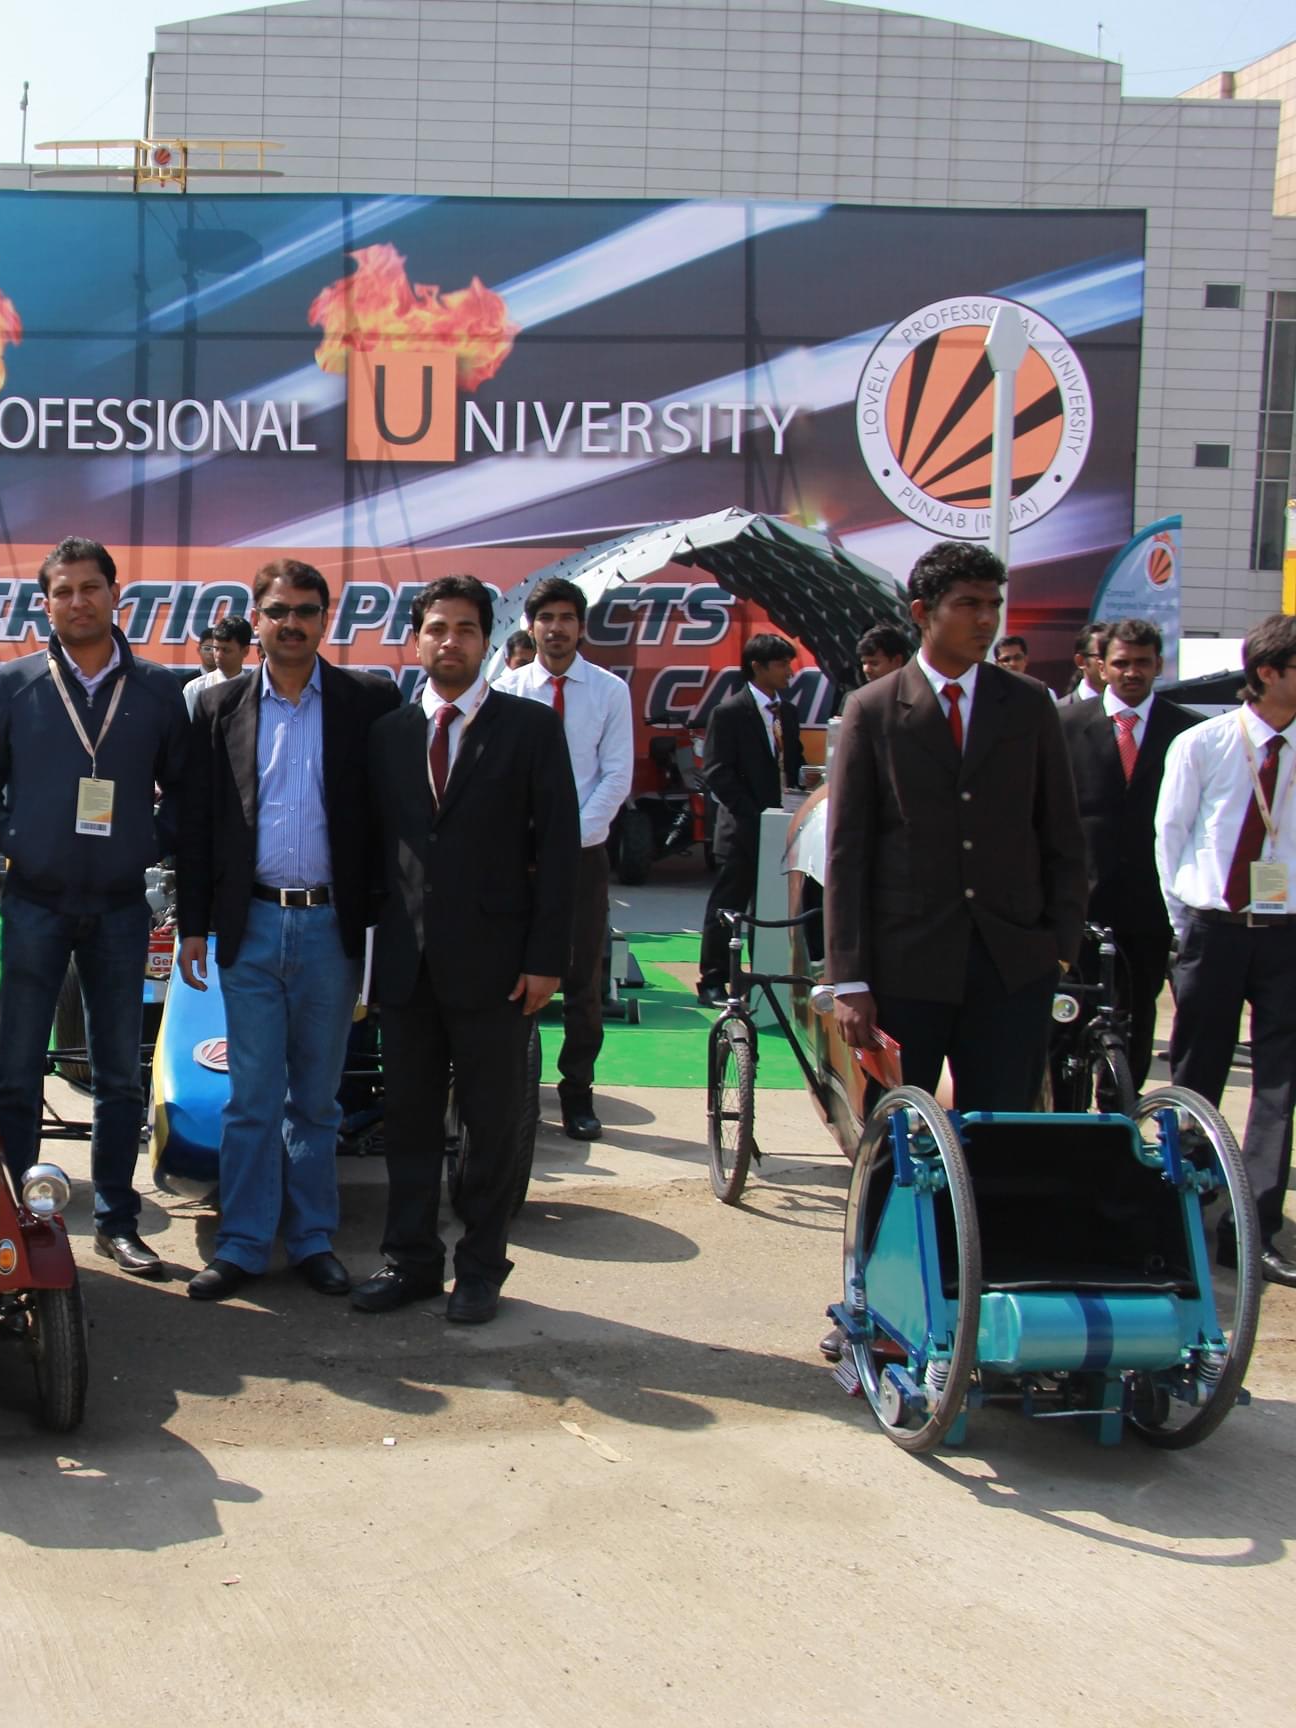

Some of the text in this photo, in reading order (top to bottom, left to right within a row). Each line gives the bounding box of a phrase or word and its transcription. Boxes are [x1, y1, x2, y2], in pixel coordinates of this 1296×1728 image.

[863, 303, 1086, 456] LOVELY PROFESSIAL UNIVERSITY
[898, 486, 1039, 533] PUNJAB (IIA)
